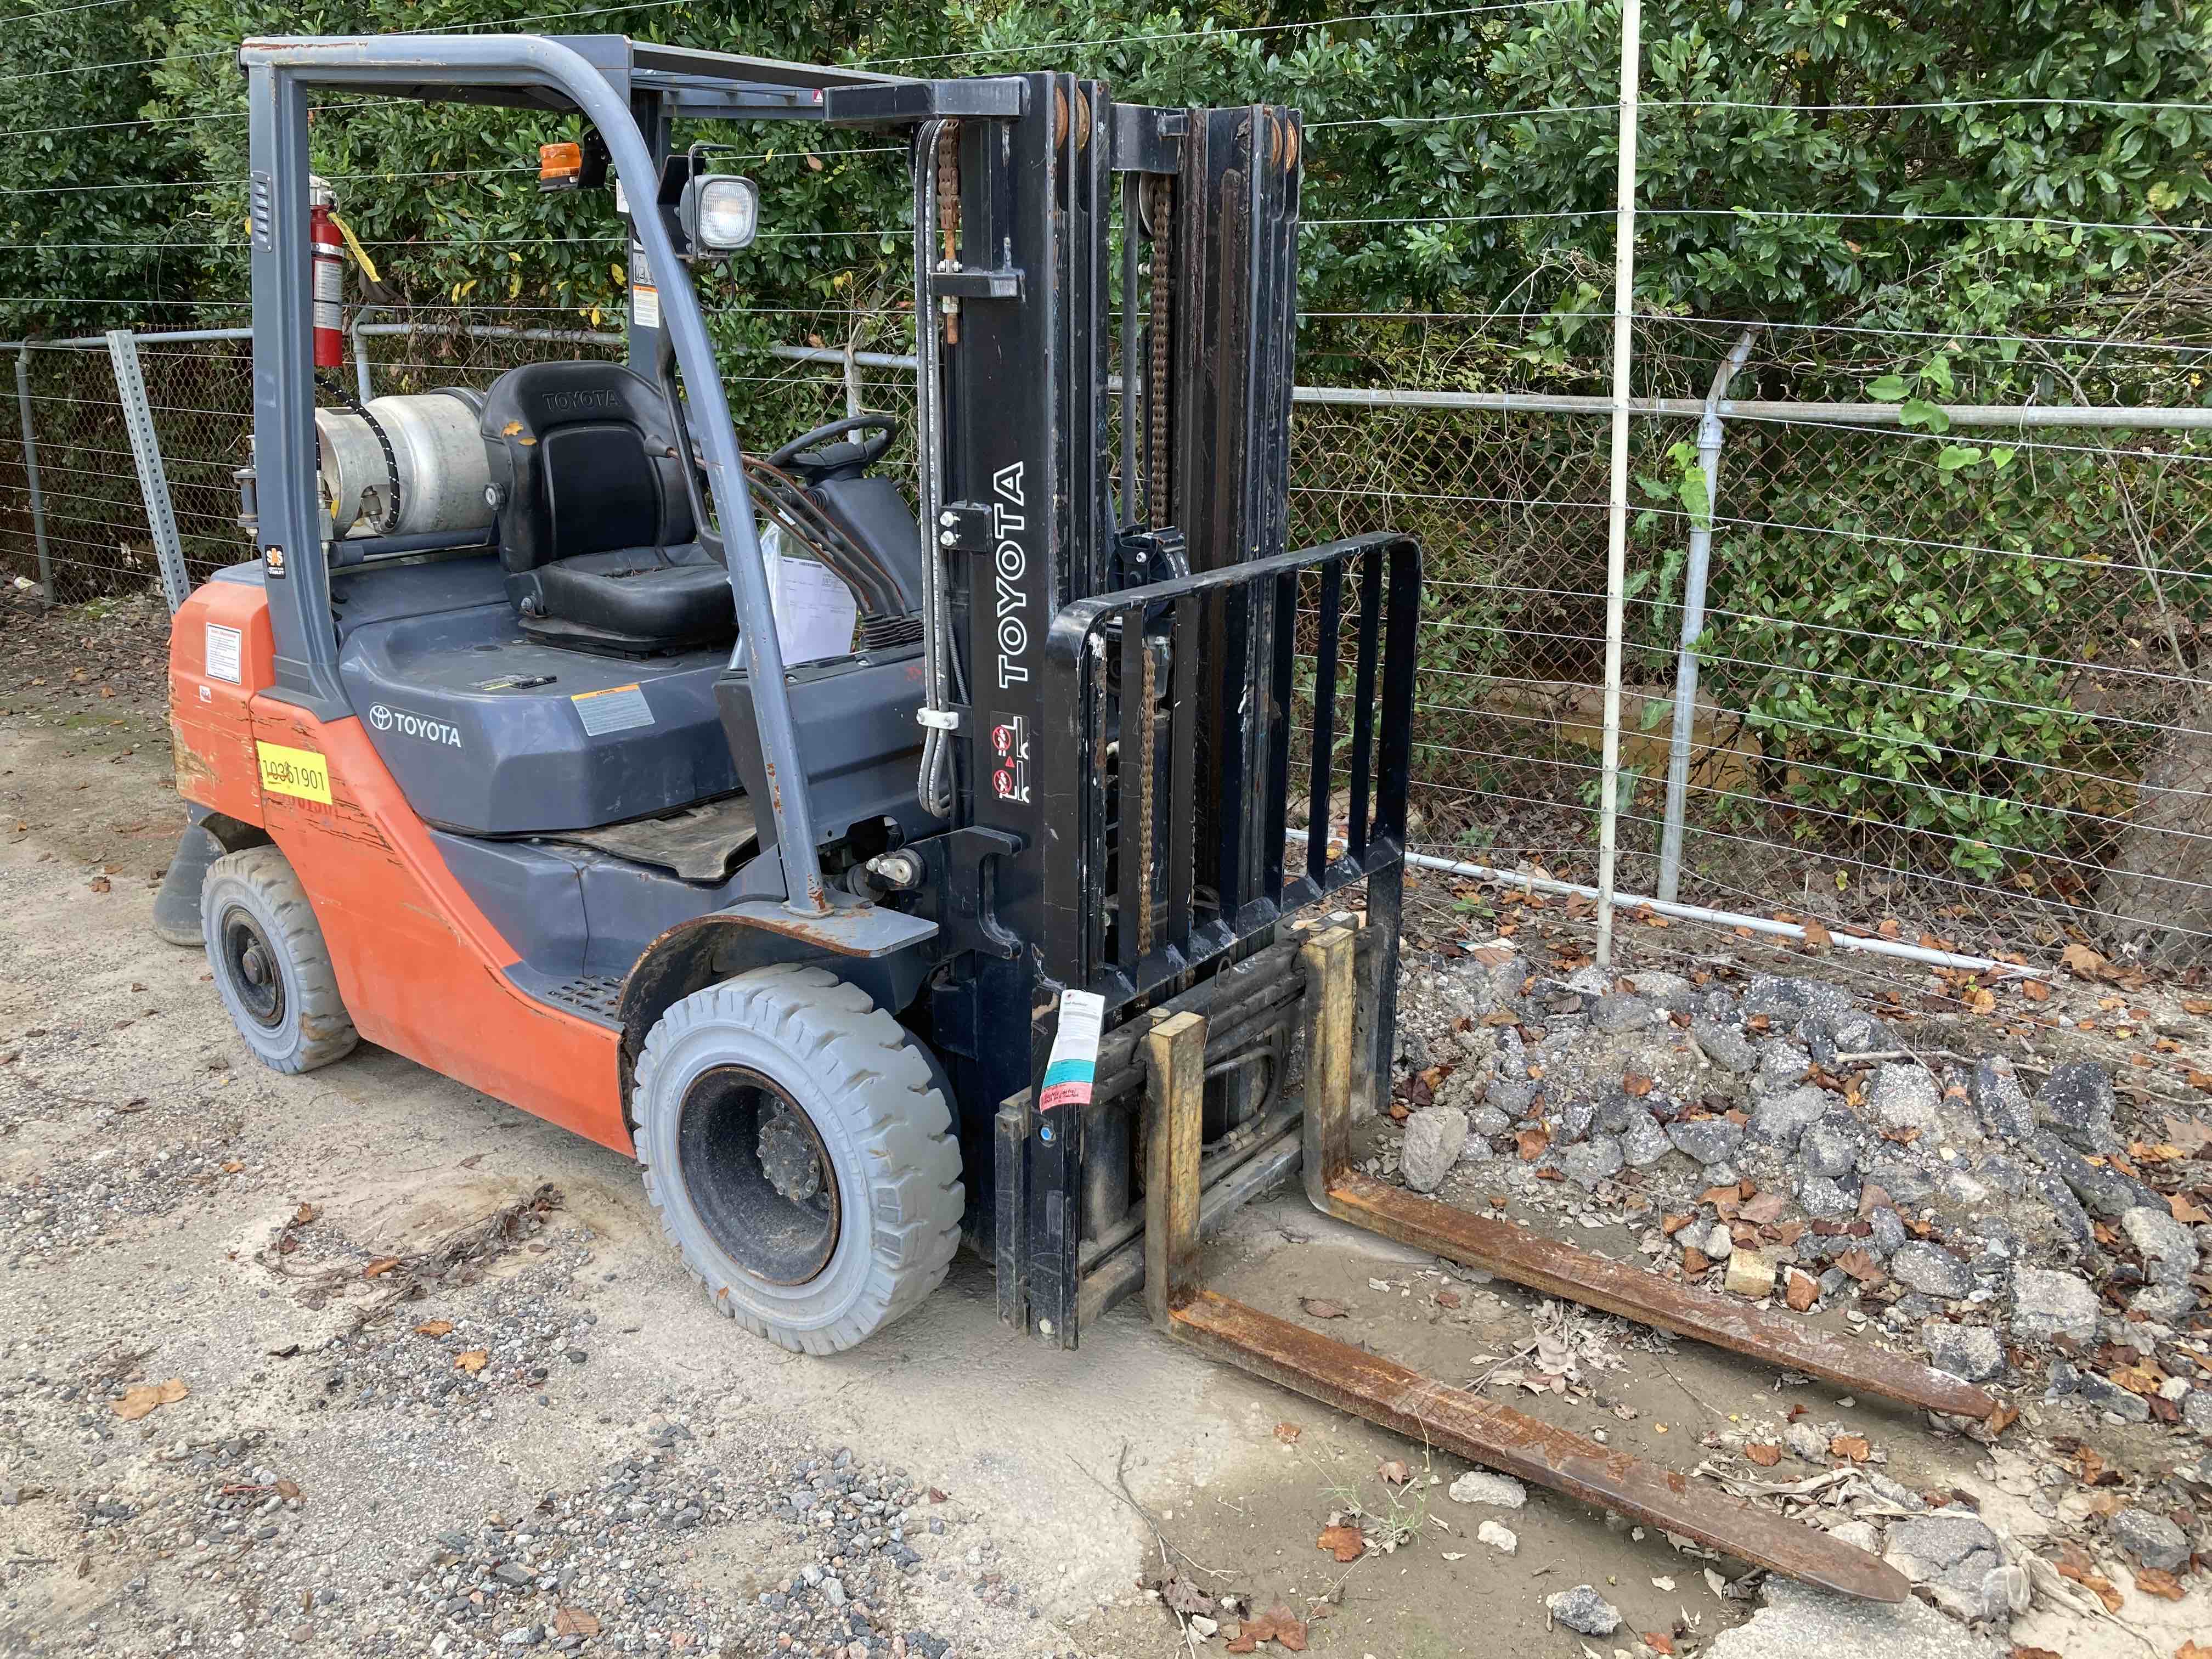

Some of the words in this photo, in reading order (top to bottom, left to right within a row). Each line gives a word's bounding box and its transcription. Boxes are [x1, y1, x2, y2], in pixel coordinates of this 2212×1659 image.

[543, 390, 622, 411] TOYOTA
[994, 460, 1028, 689] TOYOTA
[394, 713, 461, 748] TOYOTA
